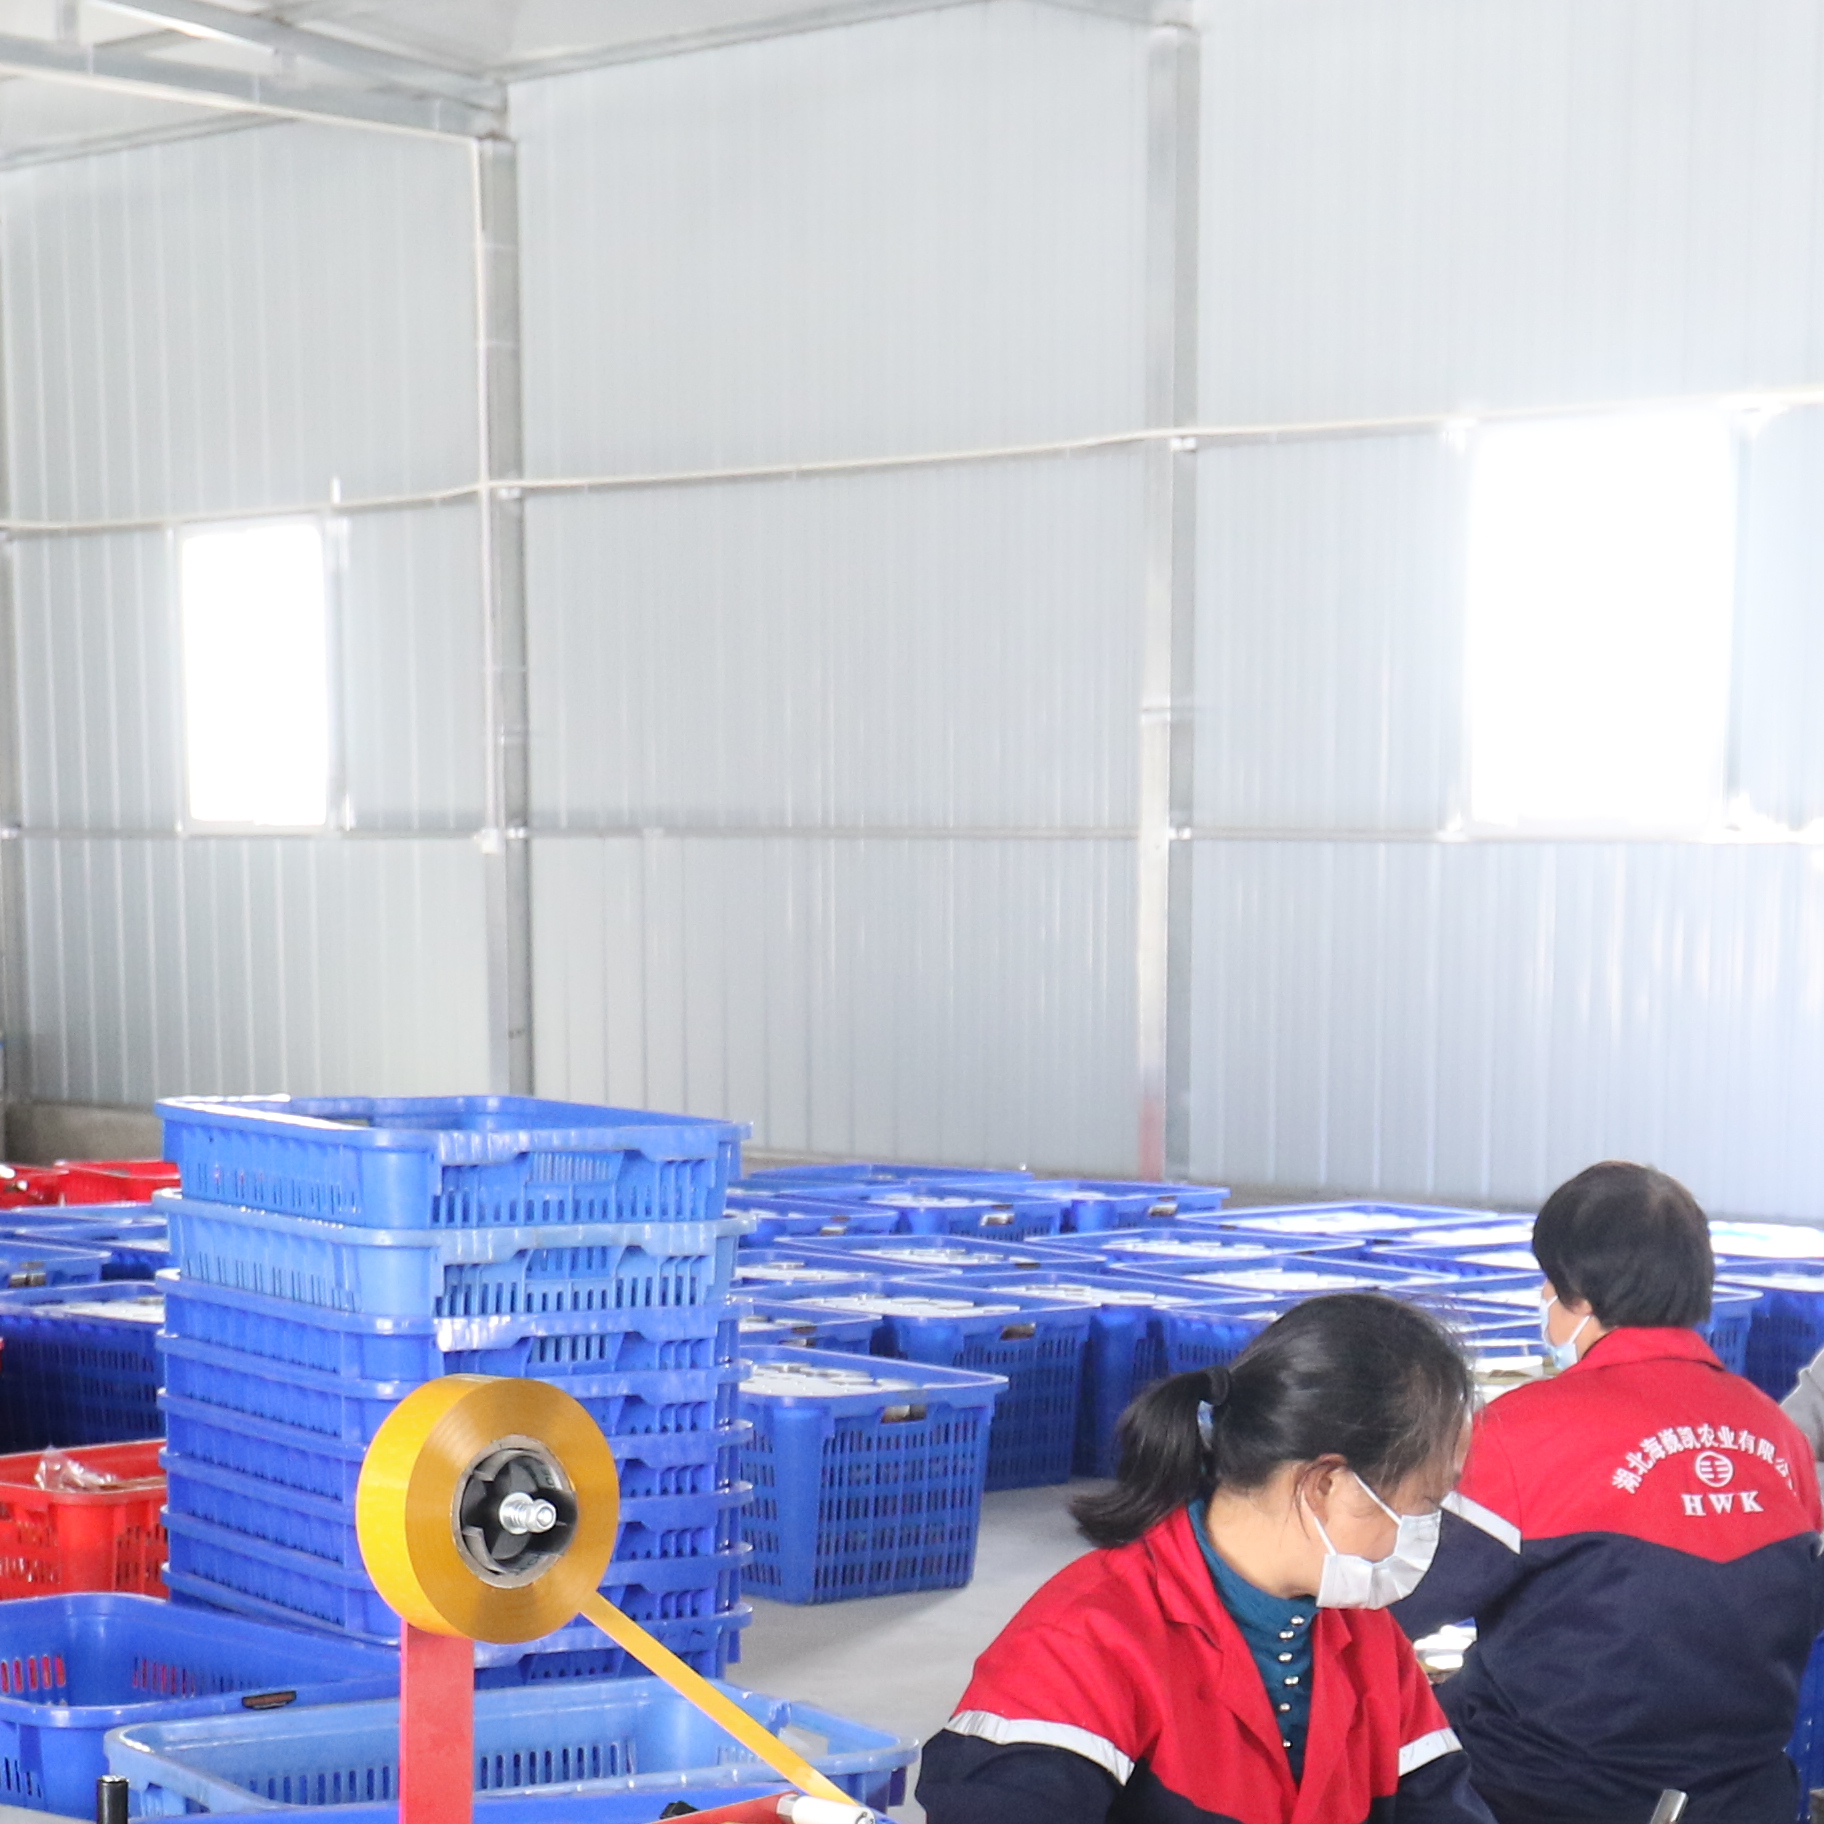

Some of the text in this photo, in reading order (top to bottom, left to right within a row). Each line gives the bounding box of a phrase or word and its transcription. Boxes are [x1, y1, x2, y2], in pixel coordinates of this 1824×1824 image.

[1611, 1423, 1798, 1496] 湖北海巍凯农业有限公
[1680, 1489, 1765, 1517] HWK
